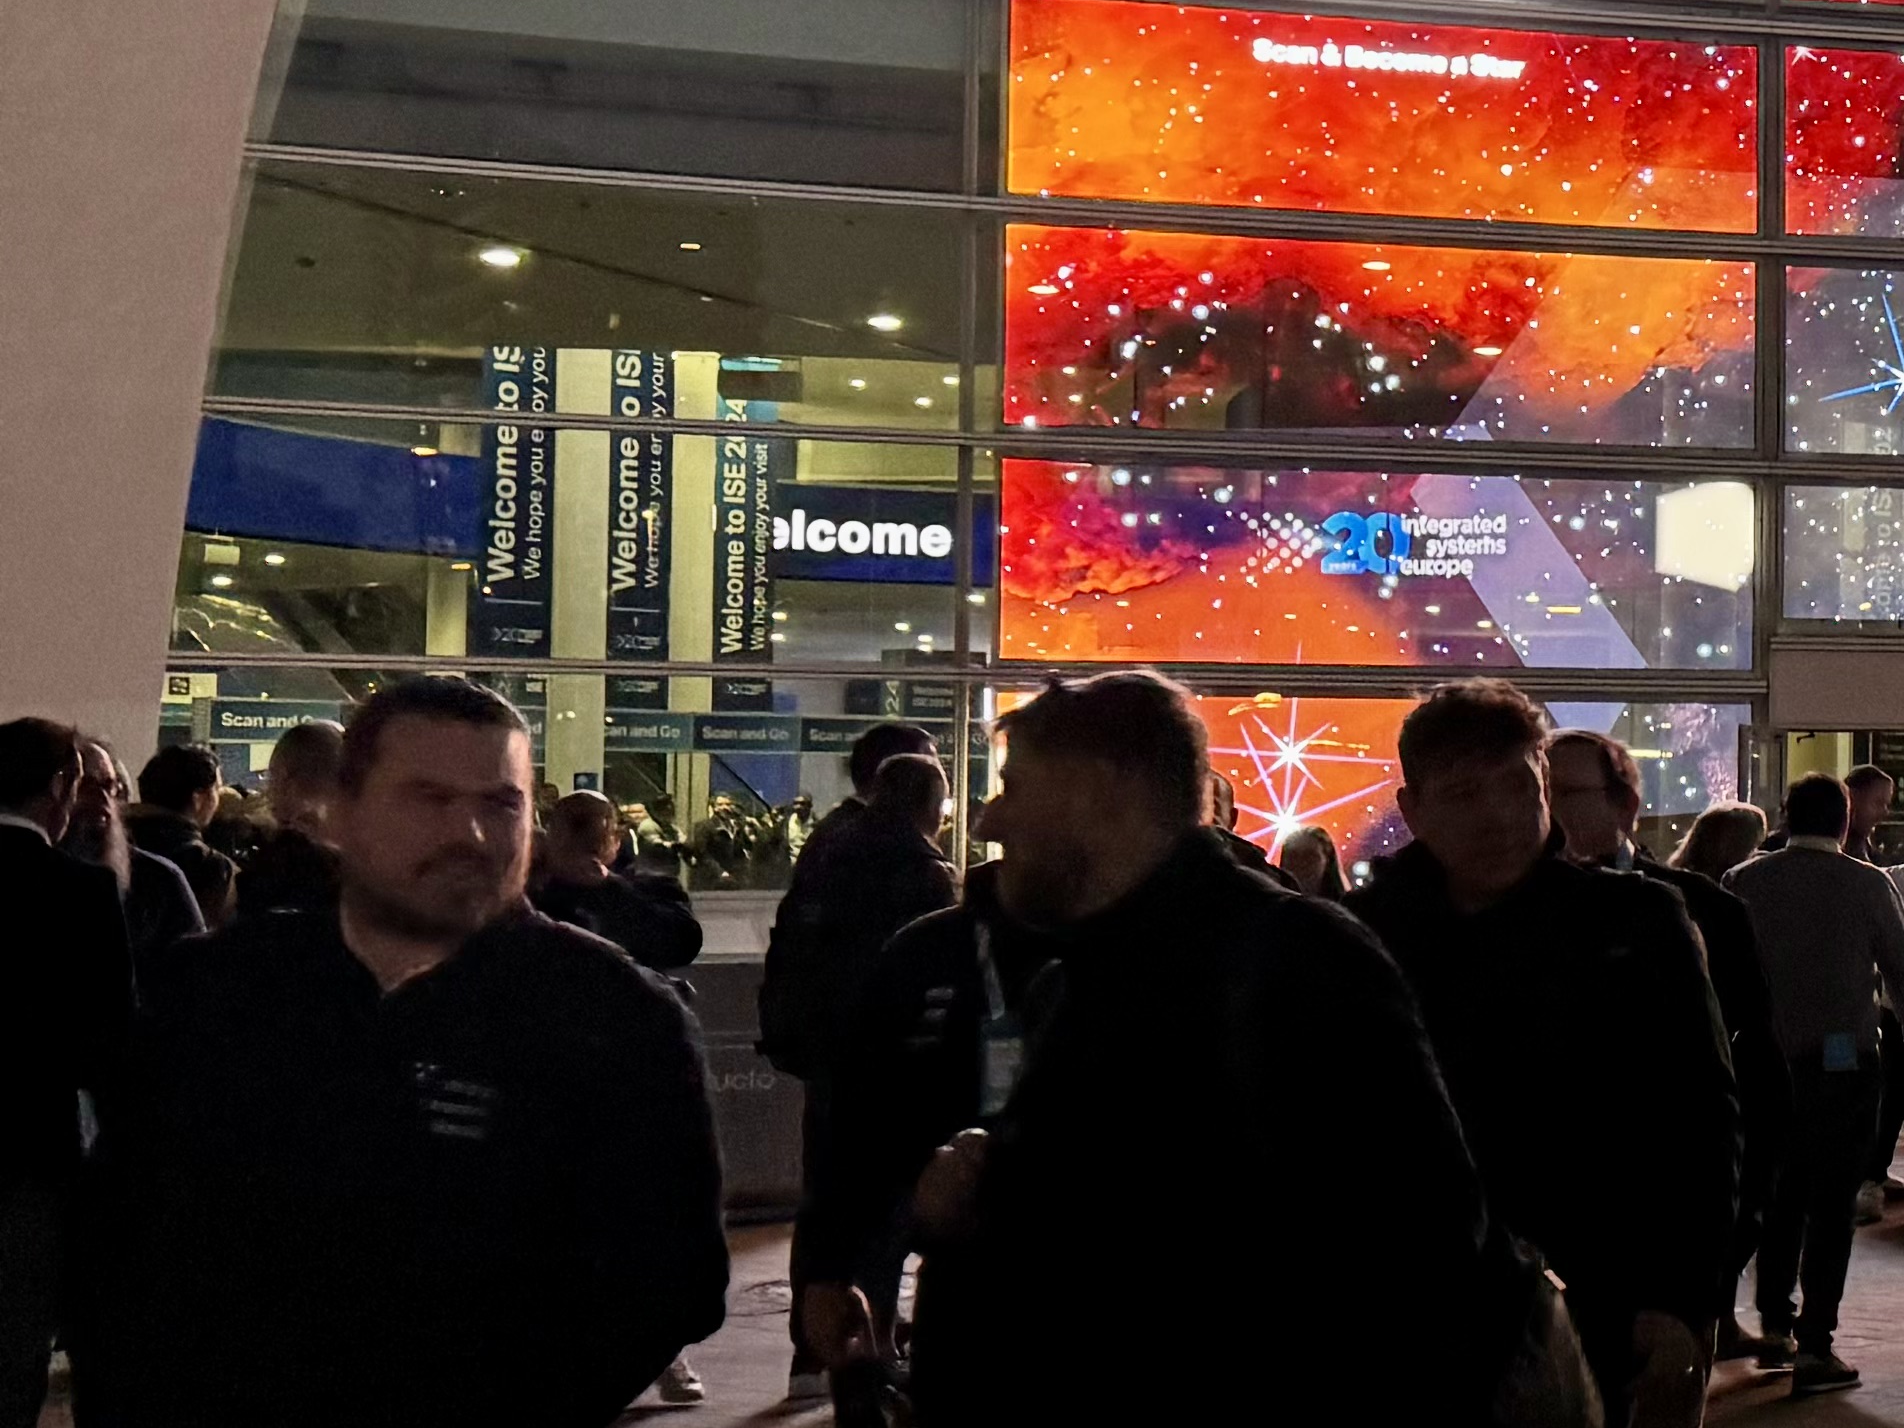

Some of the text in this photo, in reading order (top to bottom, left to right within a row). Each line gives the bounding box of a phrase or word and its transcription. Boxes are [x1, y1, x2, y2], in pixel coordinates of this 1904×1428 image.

[494, 379, 520, 412] to
[531, 444, 547, 486] you
[650, 456, 663, 496] you
[487, 424, 518, 583] Welcome
[525, 490, 546, 543] hope
[611, 437, 640, 593] Welcome
[721, 399, 747, 653] Welcome to ISE 224
[773, 508, 952, 557] elcome
[1400, 513, 1507, 537] integrated
[1320, 511, 1411, 574] 20
[1426, 534, 1506, 557] systems
[523, 548, 541, 580] We
[1400, 557, 1474, 579] europe
[222, 712, 264, 727] Scan
[266, 715, 298, 728] and
[604, 725, 681, 738] can and Go
[702, 726, 790, 740] Scan and Go
[809, 728, 843, 742] Scan
